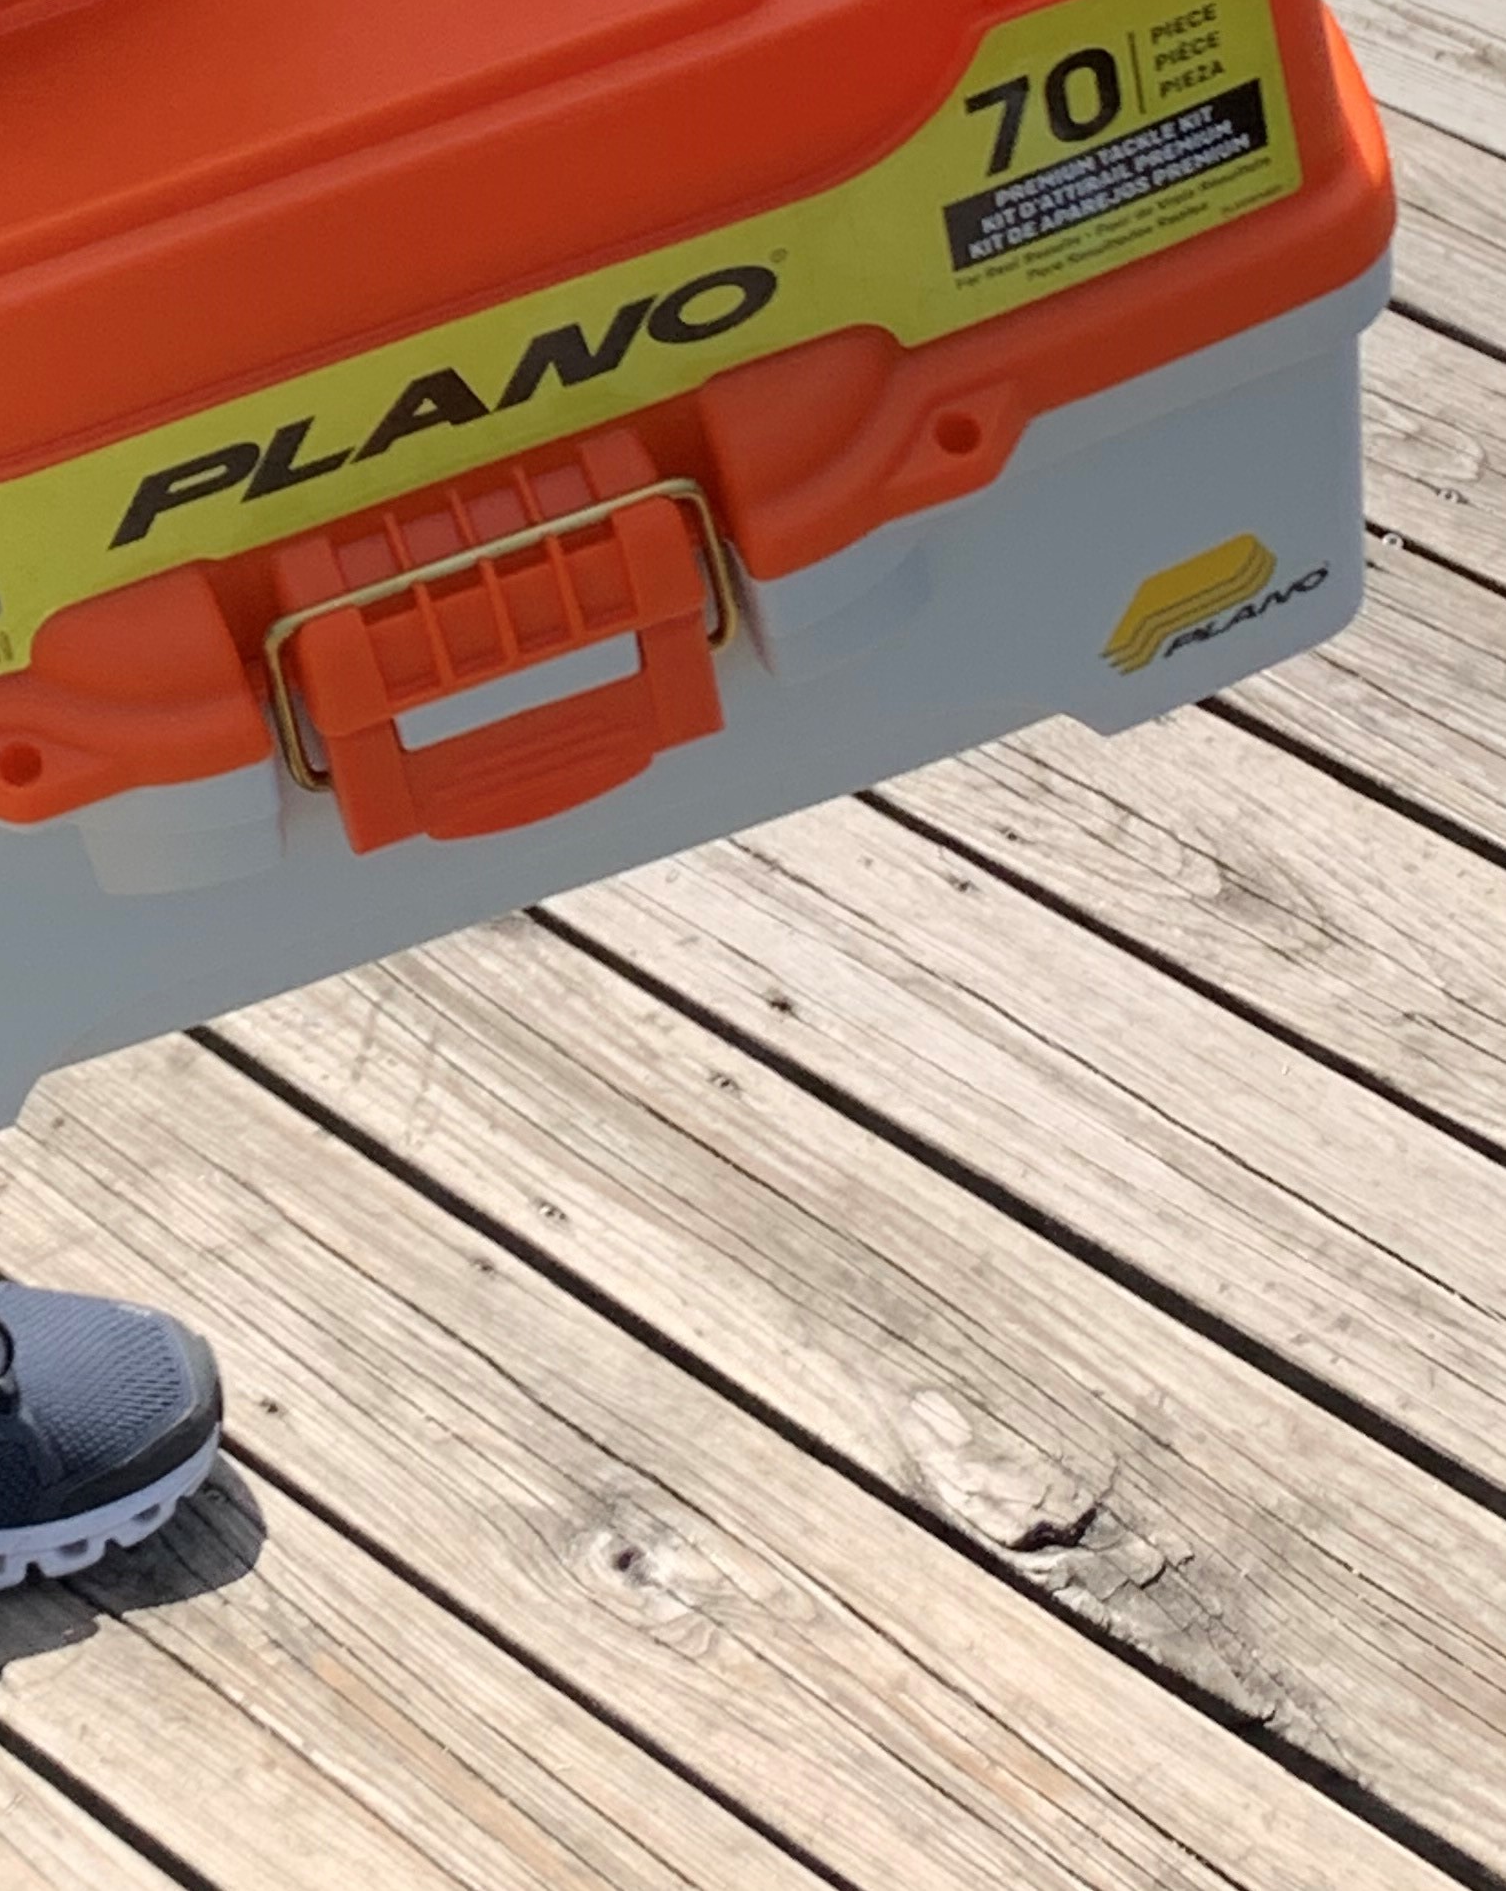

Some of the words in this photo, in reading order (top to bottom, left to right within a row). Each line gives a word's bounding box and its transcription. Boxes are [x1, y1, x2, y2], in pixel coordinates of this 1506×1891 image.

[1151, 2, 1217, 45] PIECE
[964, 47, 1121, 178] 70
[1159, 59, 1225, 99] PIEZA
[968, 232, 1004, 260] KIT
[1006, 220, 1038, 245] DE
[1039, 175, 1150, 233] APAREJOS
[1151, 132, 1250, 187] PREMIUM
[981, 207, 1016, 234] KIT
[1134, 119, 1233, 173] PREMIUM
[995, 154, 1096, 208] PREMIUM
[1096, 121, 1176, 165] TACKLE
[1178, 104, 1213, 133] KIT
[107, 264, 778, 551] PLANO
[1163, 566, 1328, 658] PLANO
